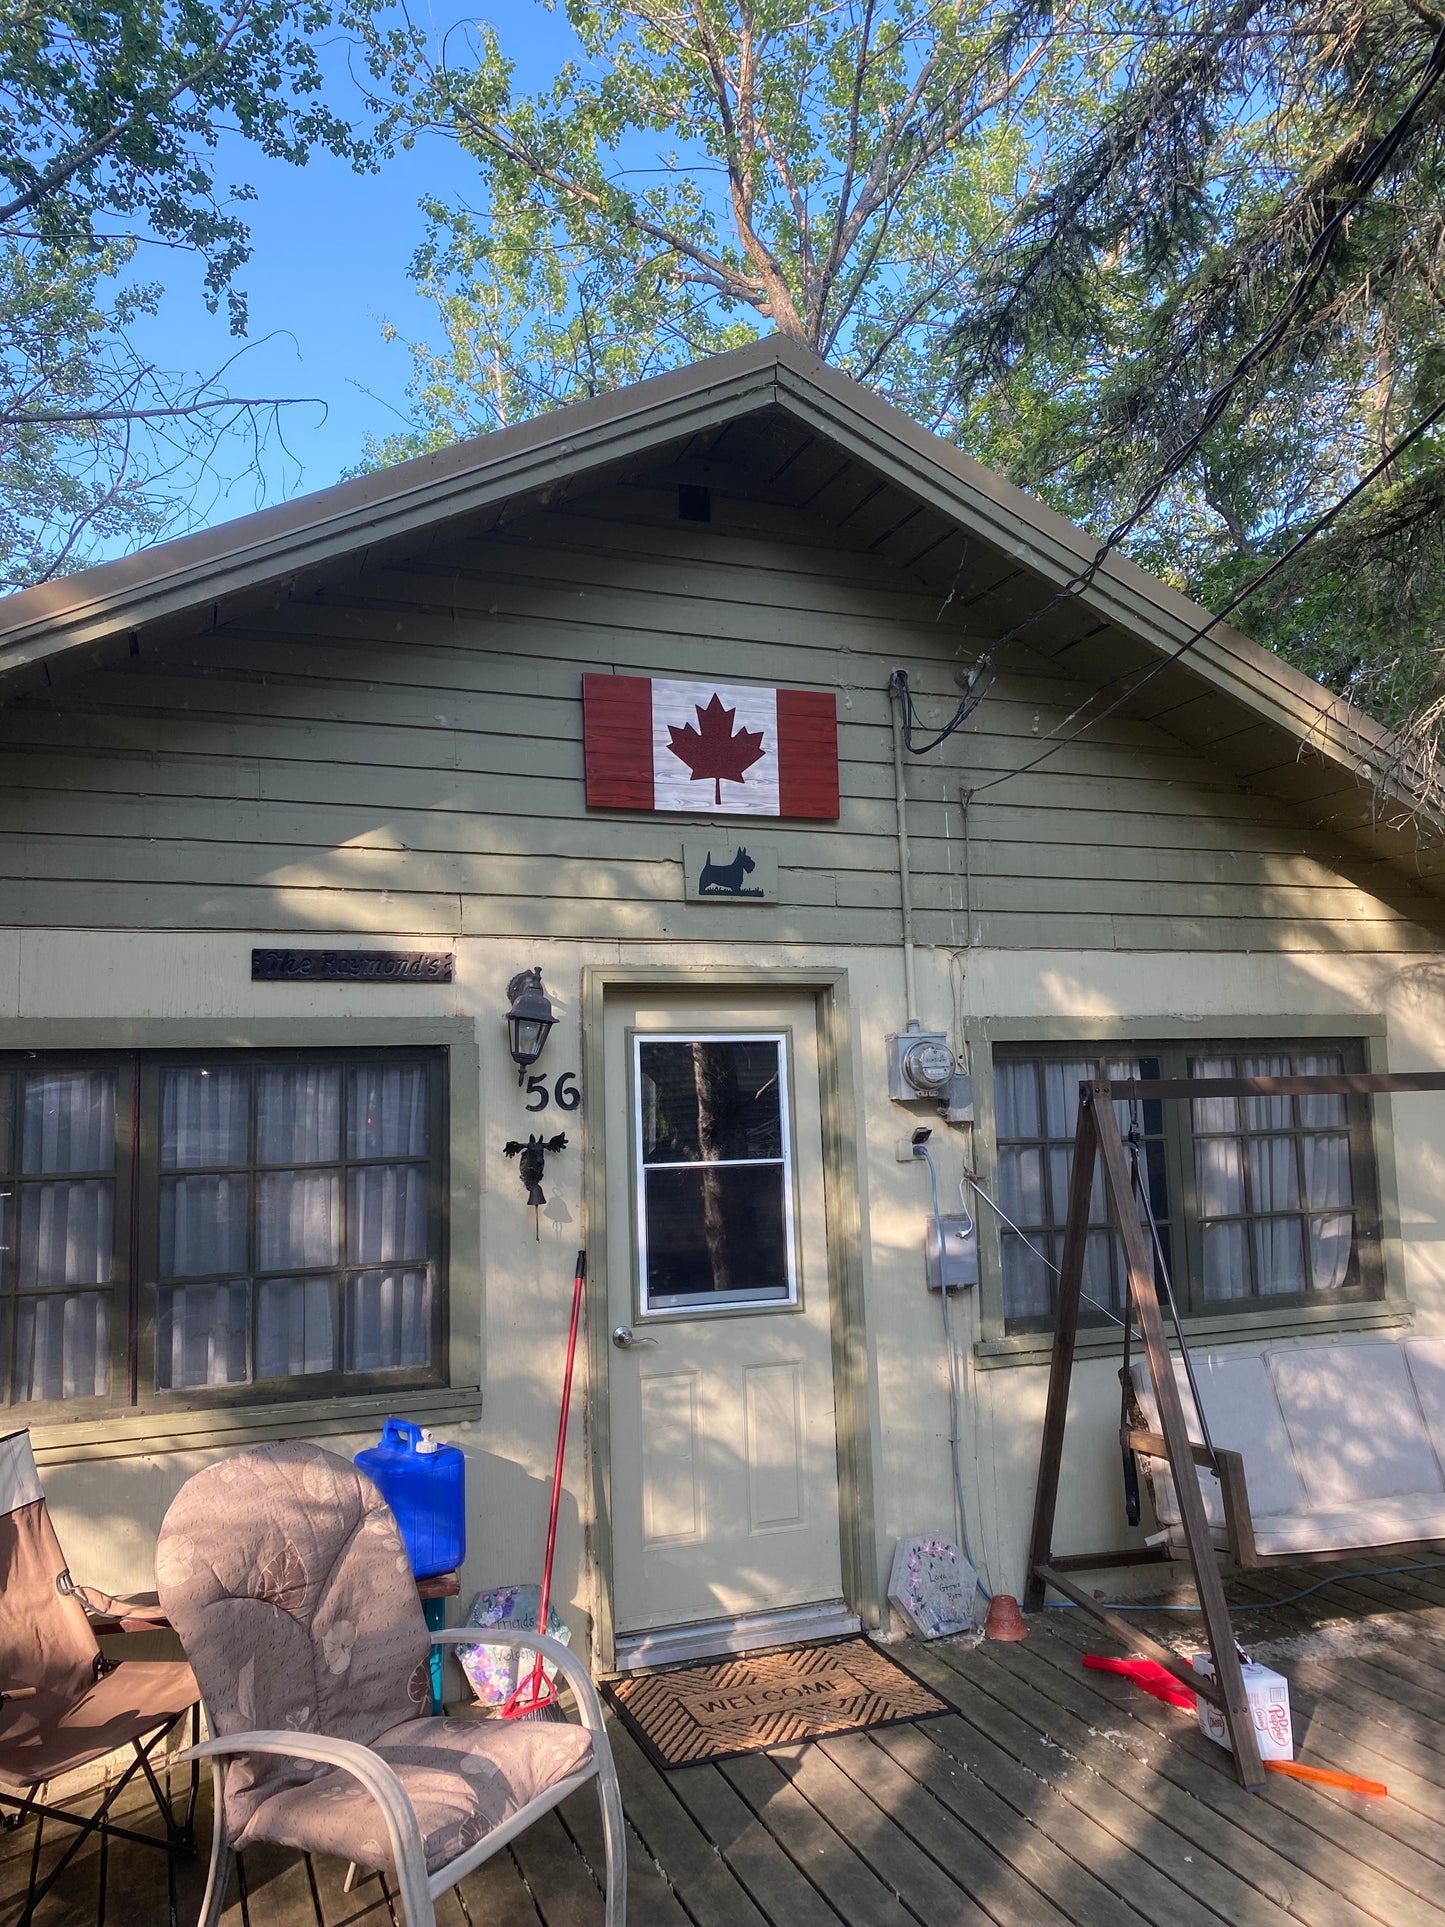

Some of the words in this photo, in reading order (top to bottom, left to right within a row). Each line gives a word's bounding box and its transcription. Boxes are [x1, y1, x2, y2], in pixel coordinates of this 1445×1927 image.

[265, 951, 313, 975] The
[525, 1071, 581, 1112] 56
[1268, 1703, 1287, 1744] Pepper
